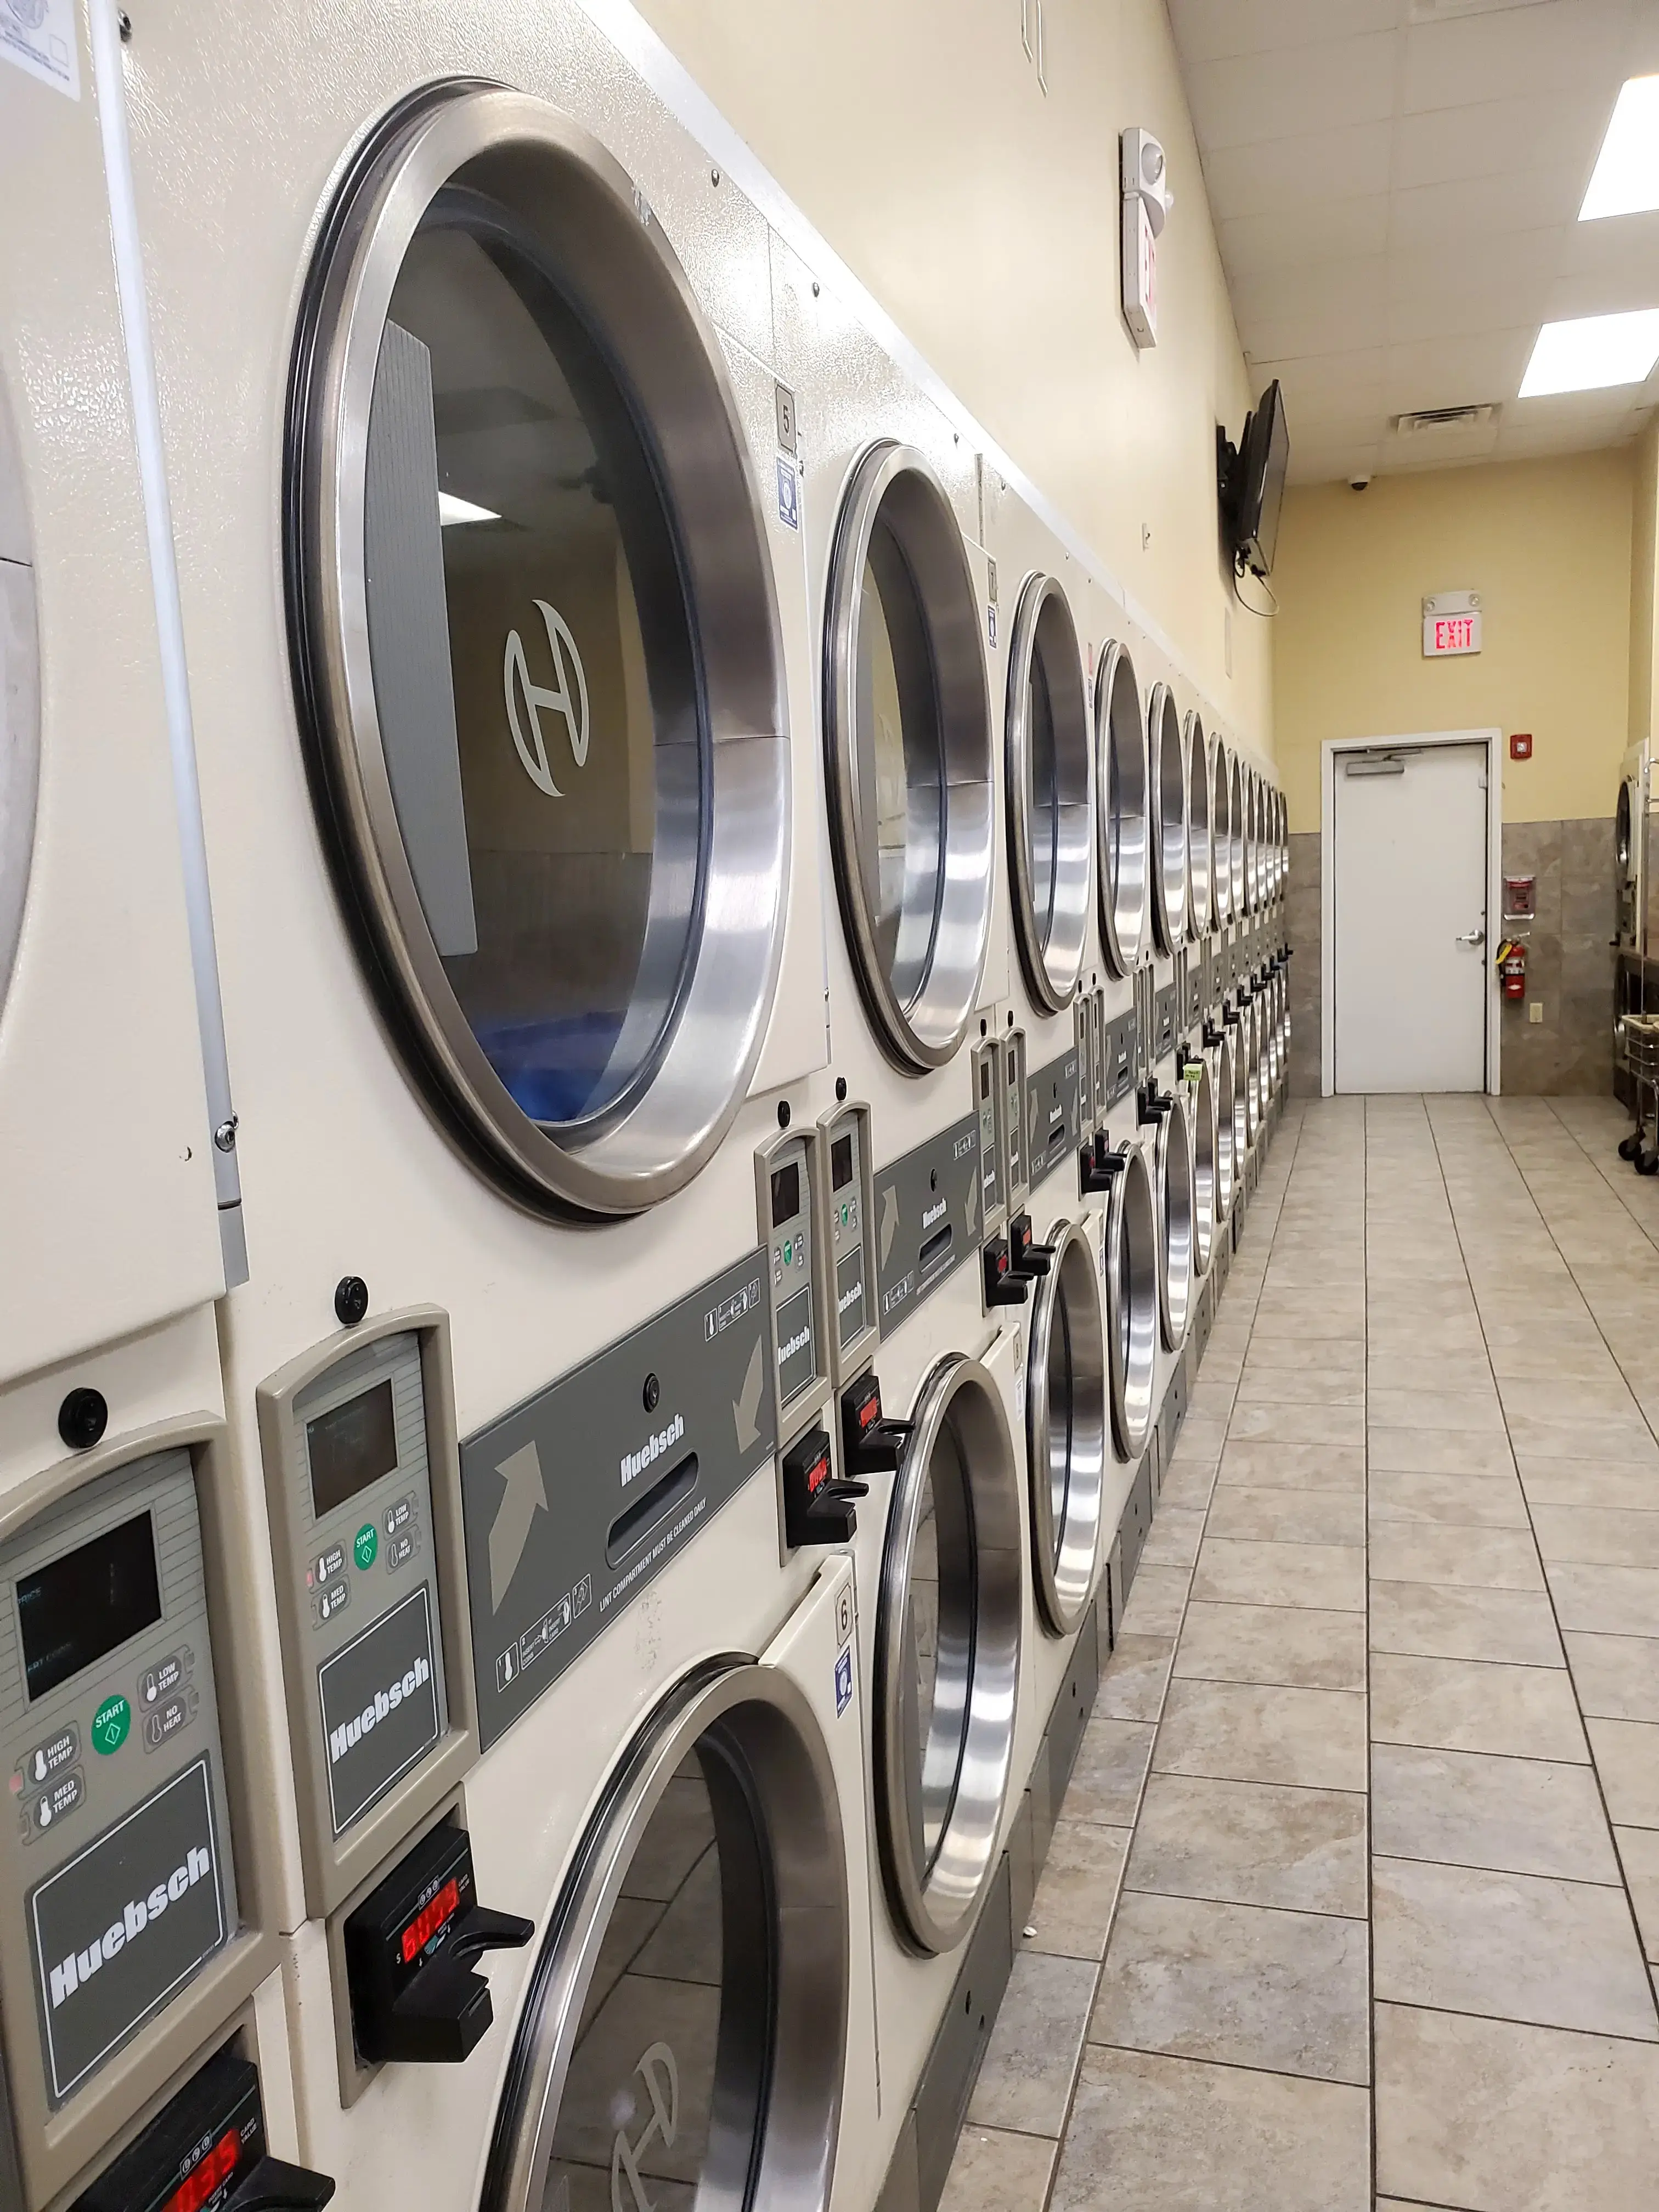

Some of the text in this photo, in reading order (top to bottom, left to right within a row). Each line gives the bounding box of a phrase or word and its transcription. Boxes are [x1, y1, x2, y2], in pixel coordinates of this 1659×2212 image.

[783, 404, 789, 434] 5
[1435, 618, 1474, 650] EXIT
[620, 1413, 684, 1487] Huebsch
[395, 1511, 409, 1526] TEMP
[396, 1503, 407, 1517] LOW
[357, 1528, 375, 1548] START
[400, 1538, 408, 1549] NO
[326, 1549, 341, 1565] HIGH
[399, 1545, 411, 1559] HEAT
[600, 1497, 706, 1612] LINT COMPARTMENT MUST BE CLEANED DAILY
[326, 1558, 342, 1574] TEMP
[330, 1593, 346, 1609] TEMP
[331, 1585, 344, 1600] MED
[841, 1598, 848, 1631] 6
[157, 1671, 179, 1691] TEMP
[159, 1662, 176, 1680] LOW
[95, 1700, 125, 1729] START
[166, 1705, 178, 1720] NO
[330, 1657, 429, 1764] Huebsch
[163, 1713, 182, 1732] HEAT
[47, 1735, 70, 1758] HIGH
[48, 1745, 74, 1769] TEMP
[54, 1780, 75, 1802] MED
[52, 1790, 78, 1813] TEMP
[49, 1846, 210, 2009] Huebsch
[240, 2117, 255, 2137] CARD
[241, 2122, 258, 2145] VALUE
